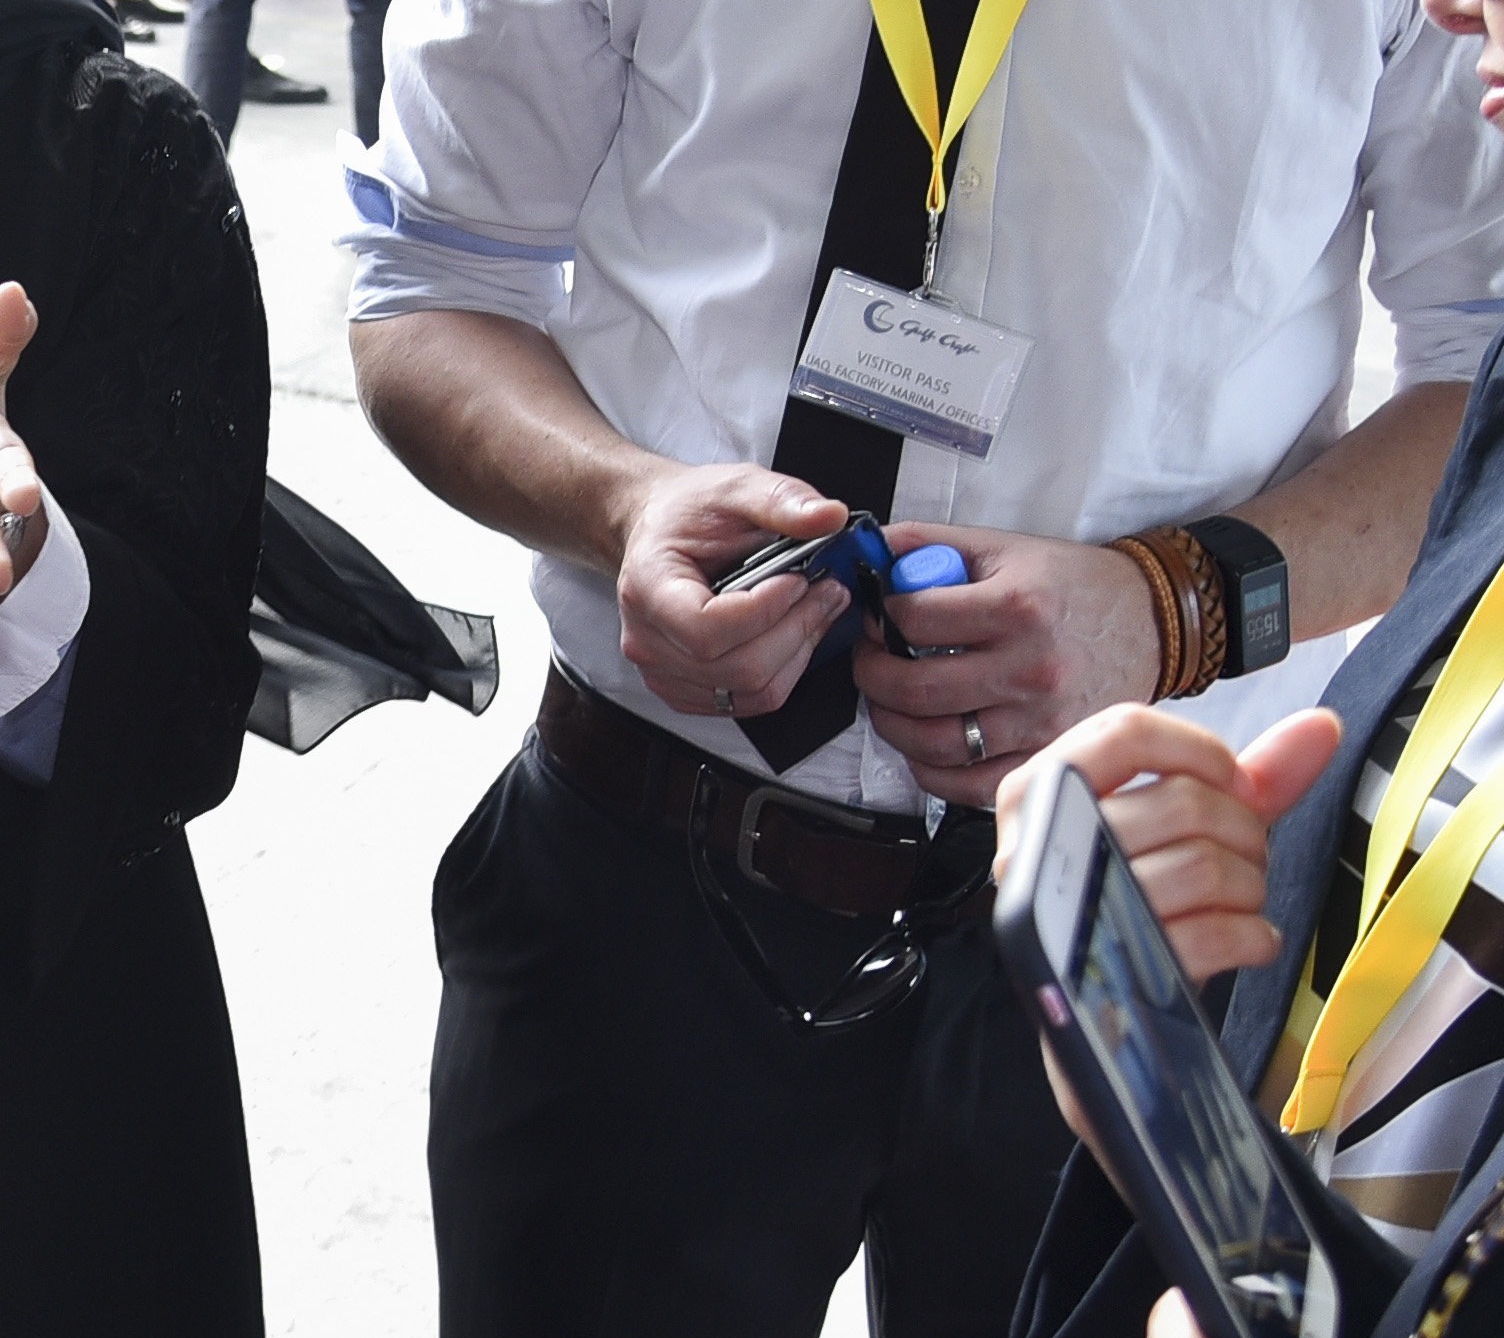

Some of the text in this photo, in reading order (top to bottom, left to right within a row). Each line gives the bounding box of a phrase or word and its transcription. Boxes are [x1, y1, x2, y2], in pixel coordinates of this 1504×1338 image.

[857, 349, 953, 395] VISITOR PASS
[890, 384, 935, 410] MARINA
[945, 404, 992, 430] OFFICES
